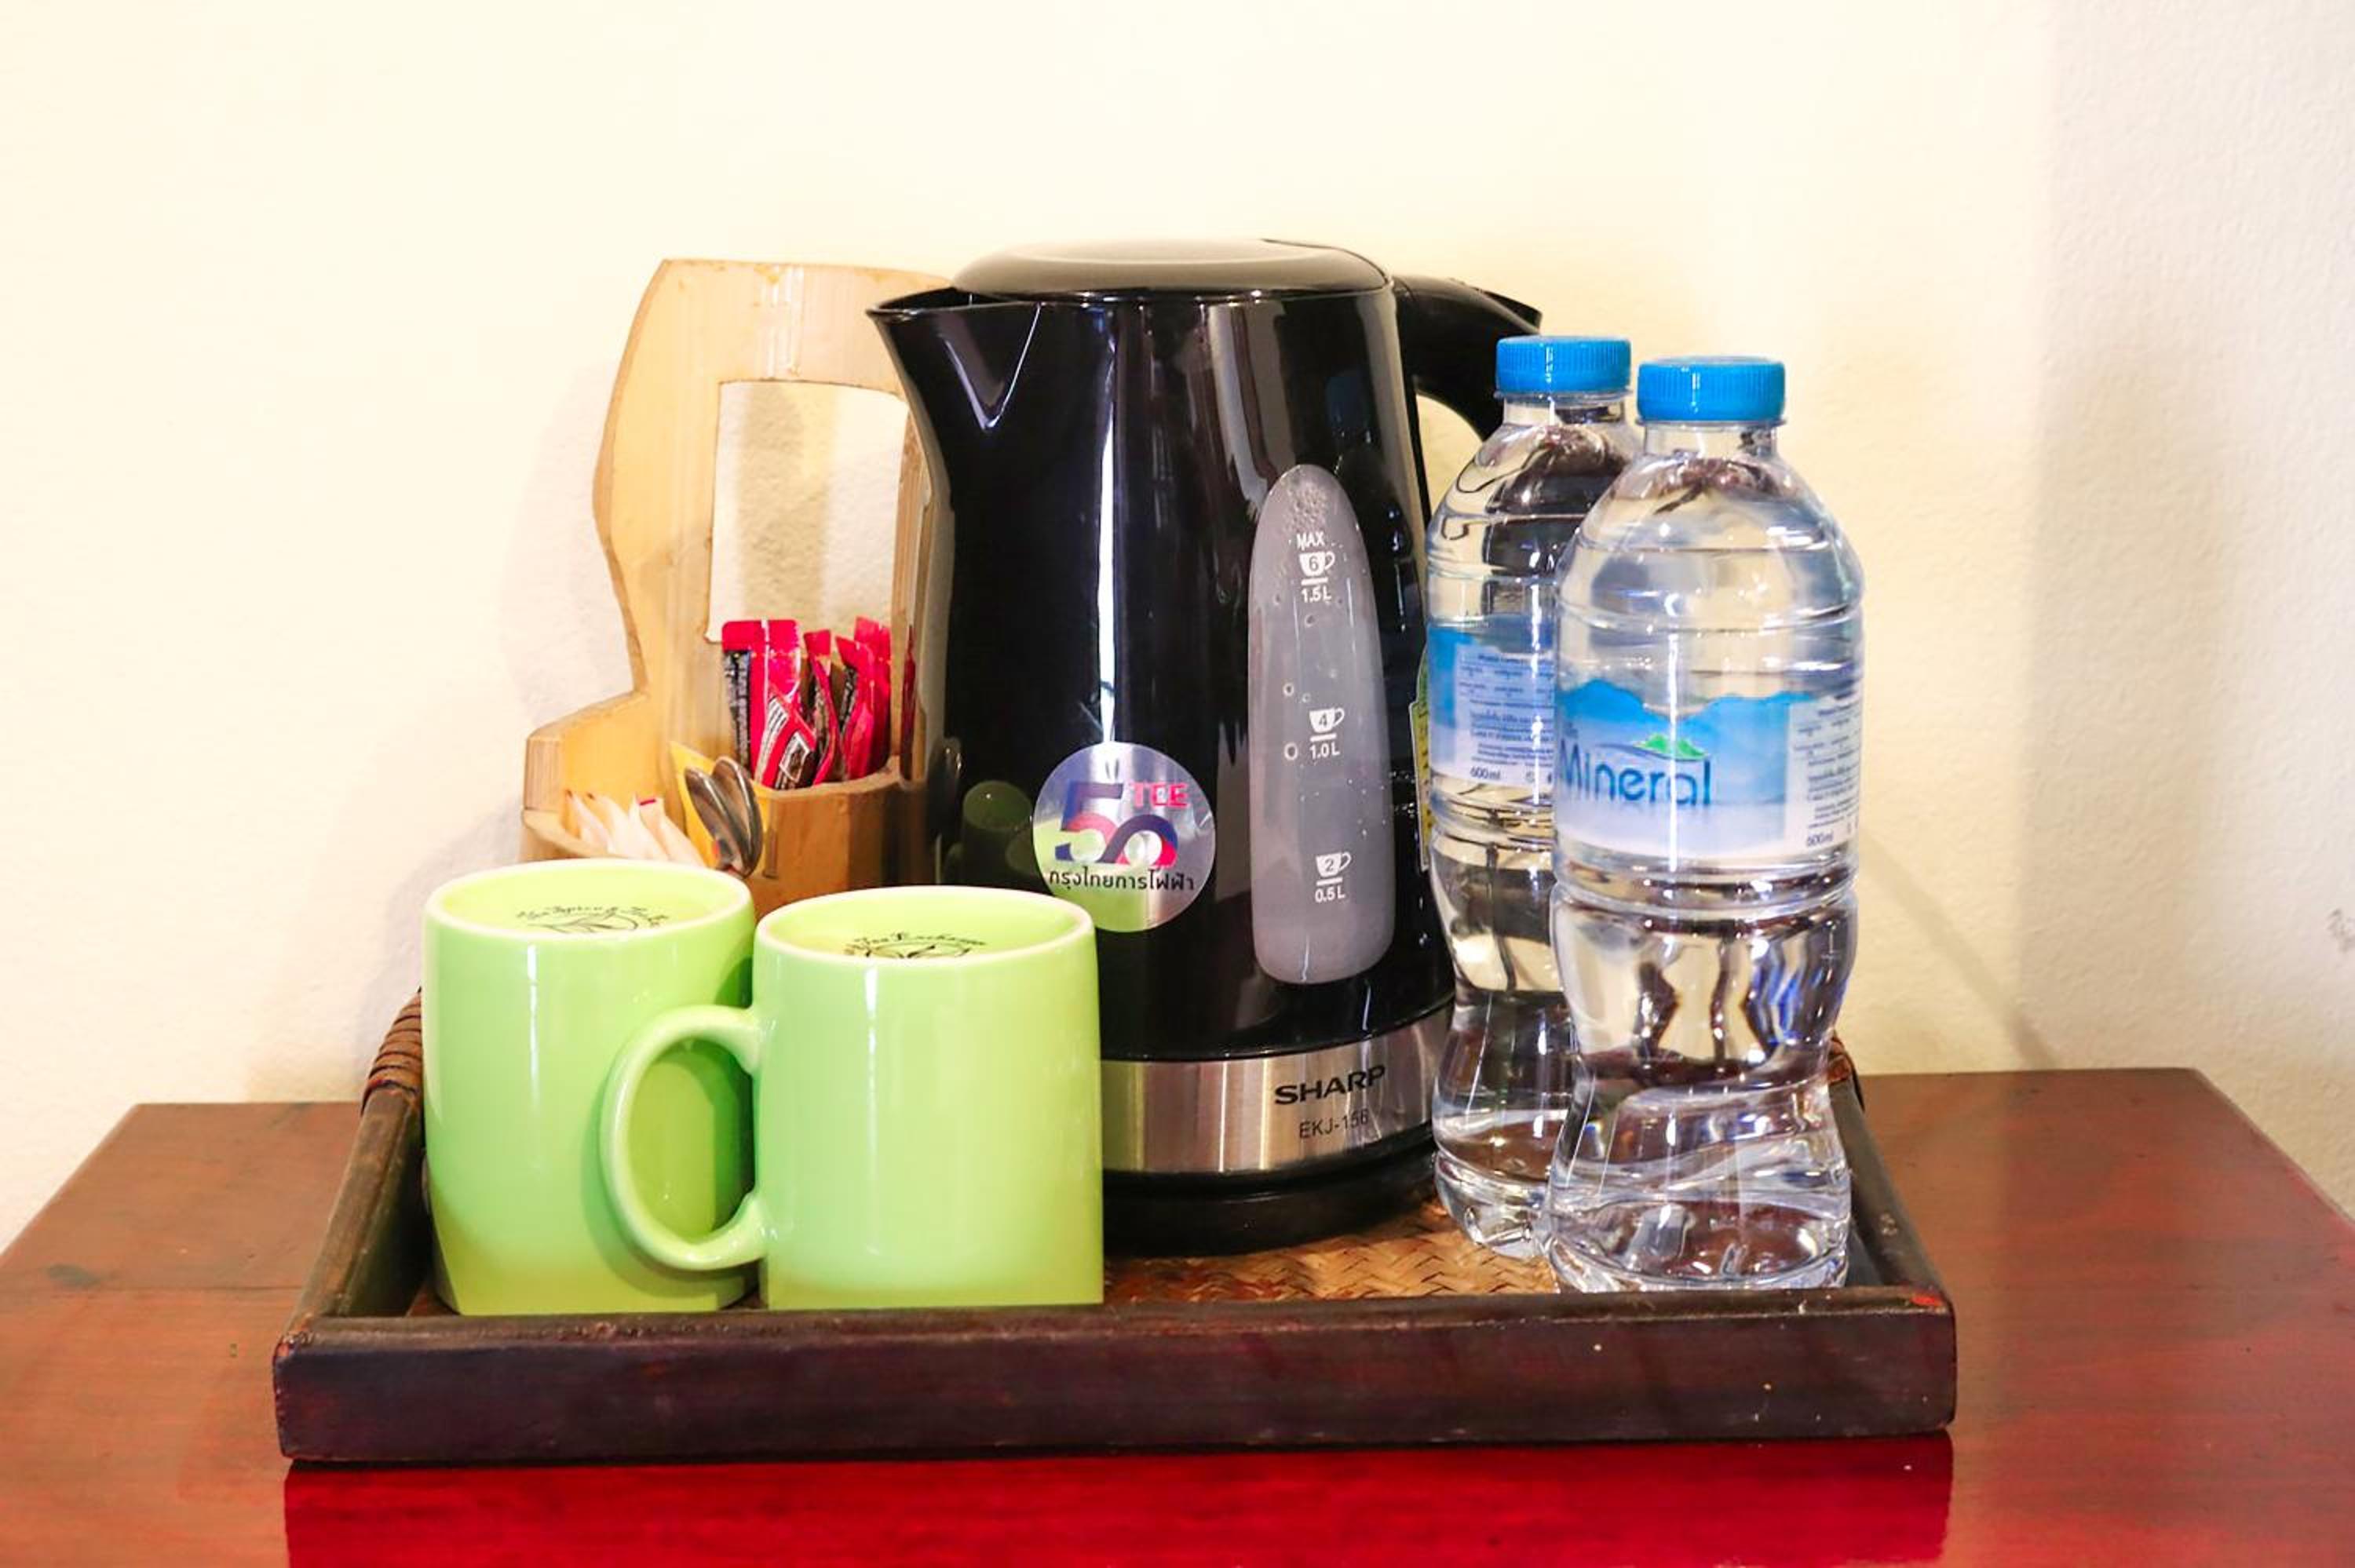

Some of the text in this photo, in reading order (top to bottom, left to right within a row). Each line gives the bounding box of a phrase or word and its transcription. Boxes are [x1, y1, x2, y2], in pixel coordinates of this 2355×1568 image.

[1297, 531, 1325, 550] MAX
[1309, 555, 1320, 572] 6
[1319, 713, 1328, 727] 4
[1558, 738, 1711, 806] Mineral
[1324, 859, 1334, 873] 2
[1275, 1064, 1386, 1105] SHARP
